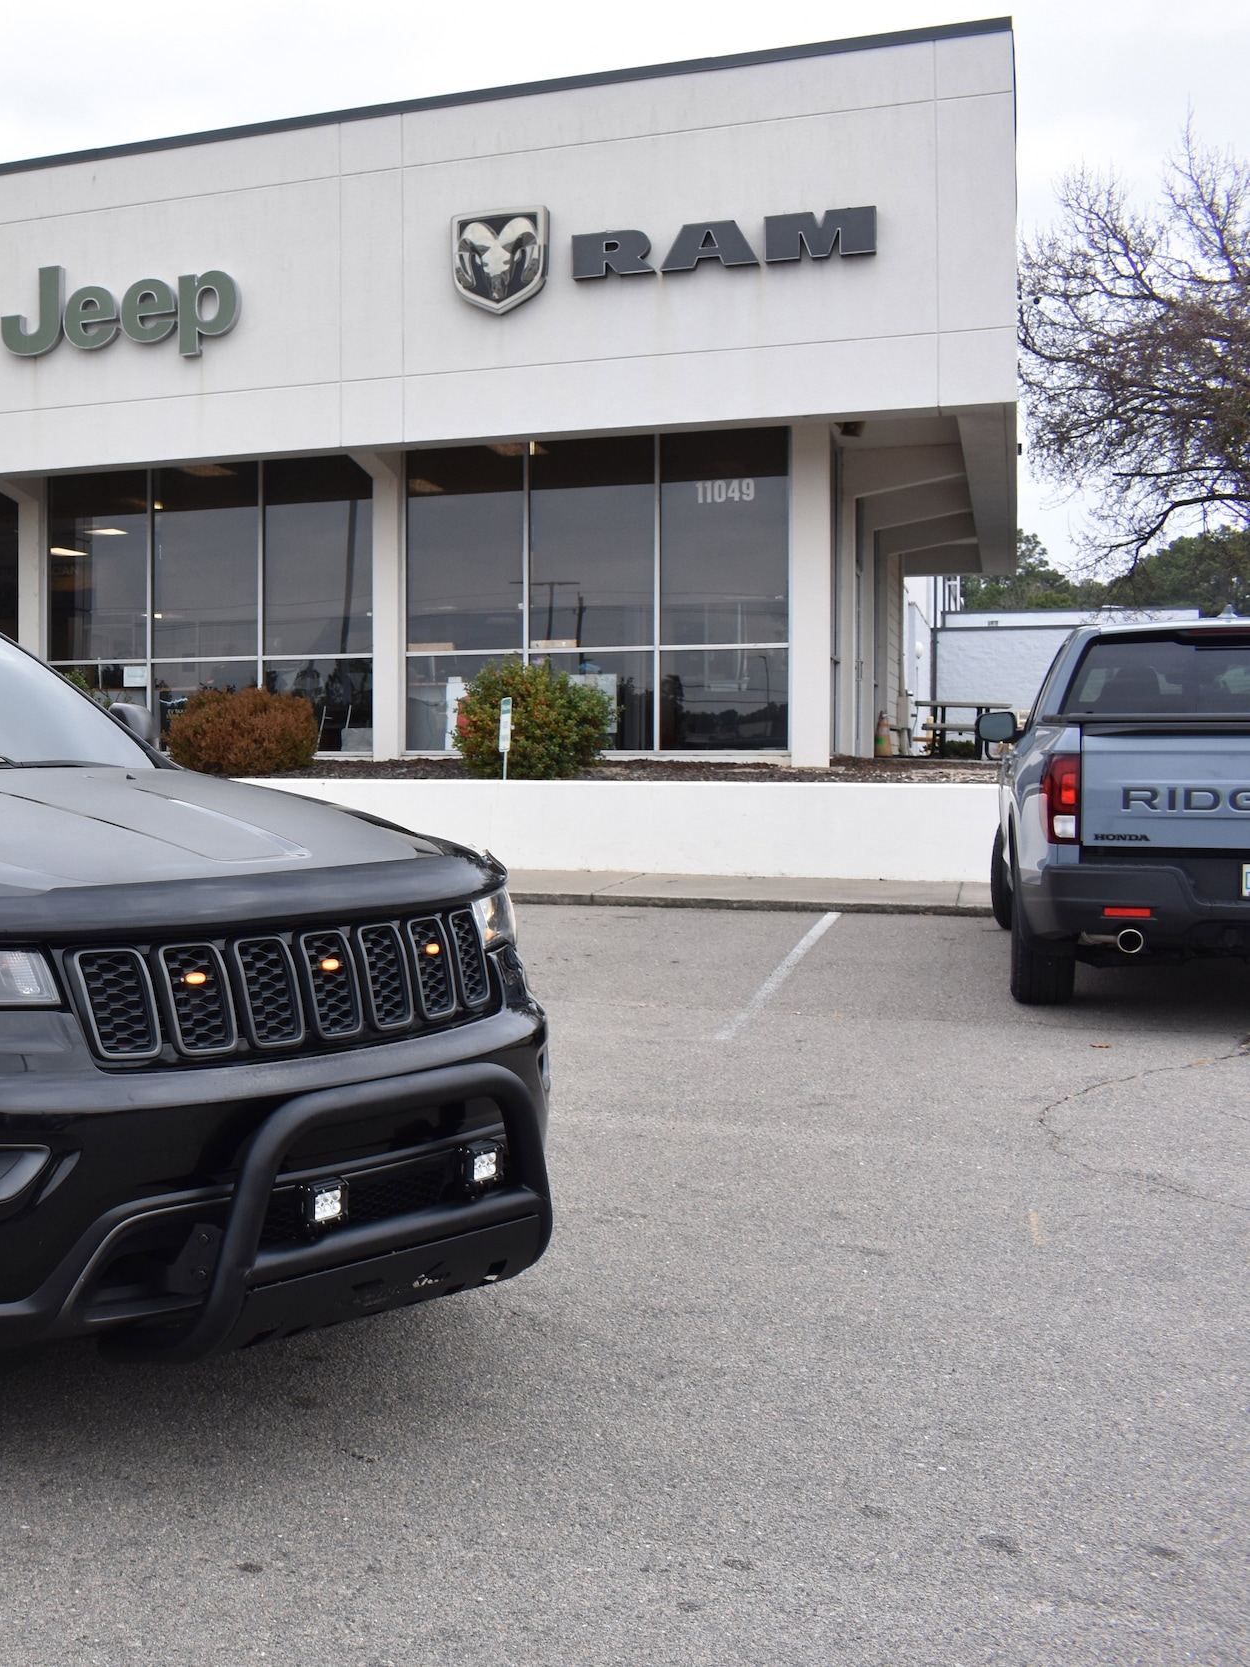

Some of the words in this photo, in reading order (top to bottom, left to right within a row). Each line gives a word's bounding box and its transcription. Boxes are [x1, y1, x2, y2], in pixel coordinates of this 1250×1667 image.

[571, 205, 877, 281] RAM
[0, 265, 242, 357] Jeep
[695, 478, 755, 504] 11049
[1093, 833, 1151, 842] HONDA
